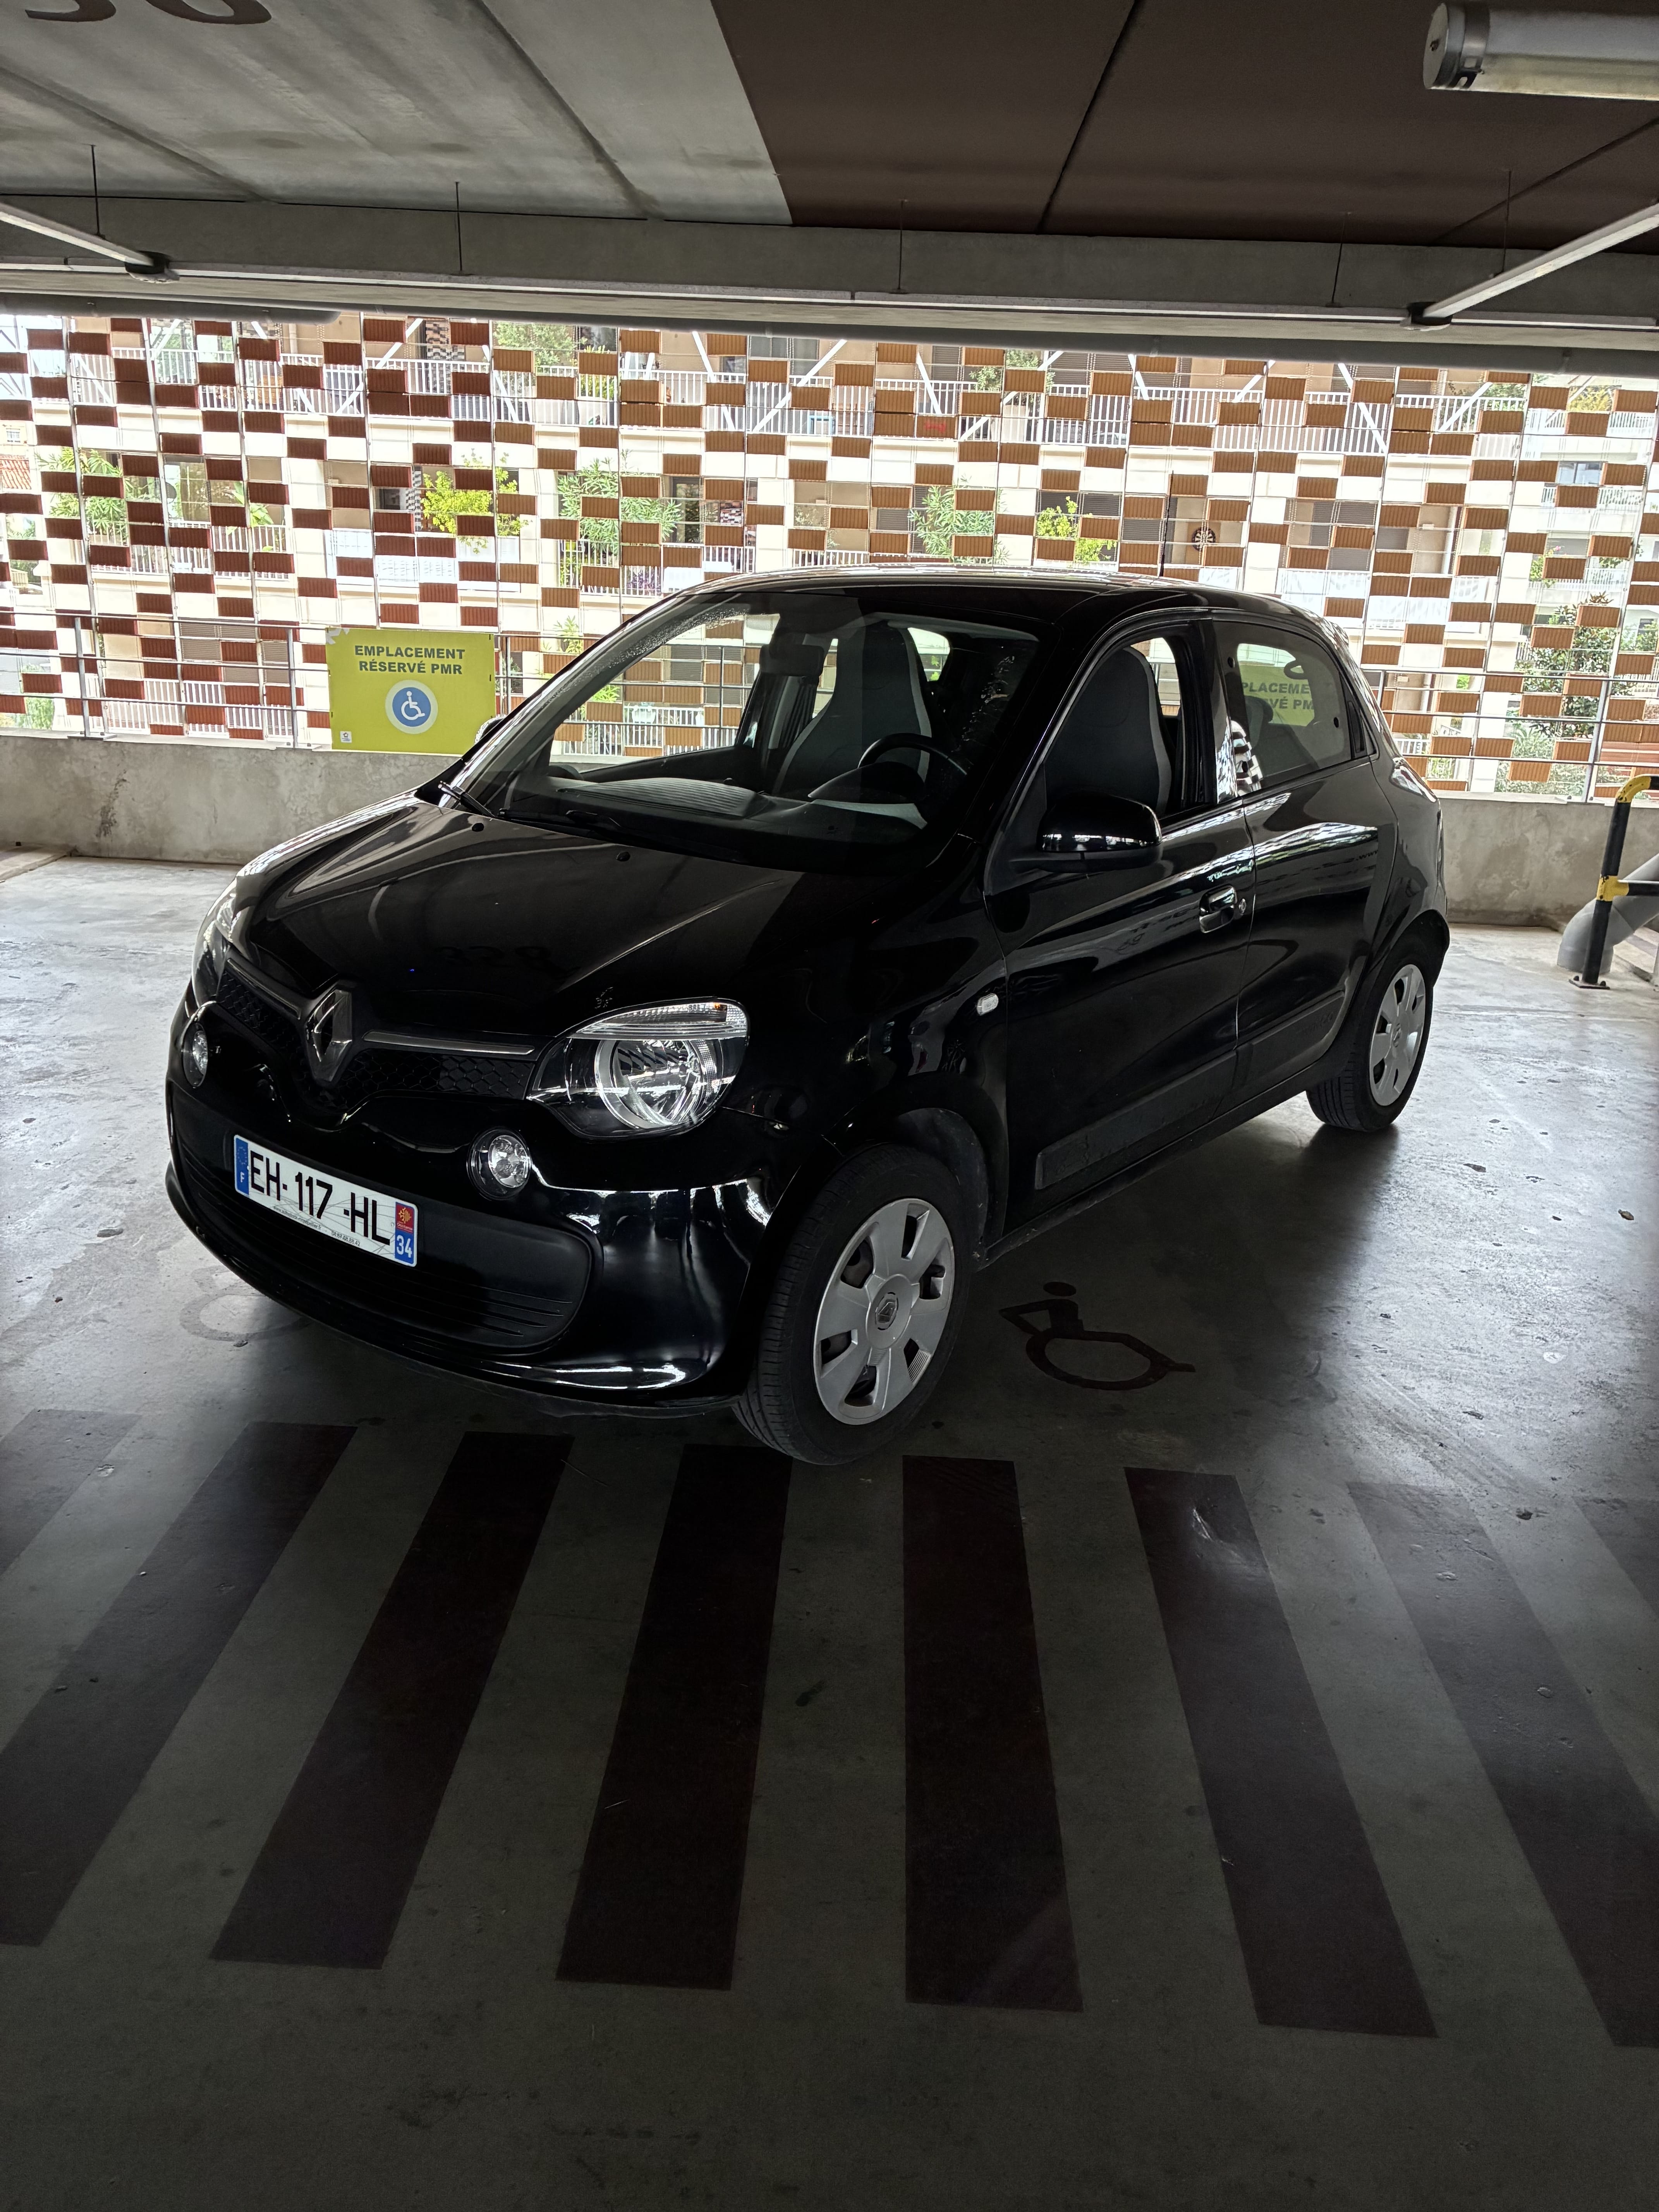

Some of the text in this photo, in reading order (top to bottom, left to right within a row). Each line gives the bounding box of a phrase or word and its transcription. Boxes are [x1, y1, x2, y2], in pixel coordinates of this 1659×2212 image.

[354, 645, 465, 659] EMPLACEMENT
[359, 659, 462, 675] RÉSERVÉ PMR
[1242, 682, 1310, 694] PLACEME
[1293, 699, 1314, 709] PM
[240, 1171, 245, 1183] F
[396, 1235, 412, 1258] 34
